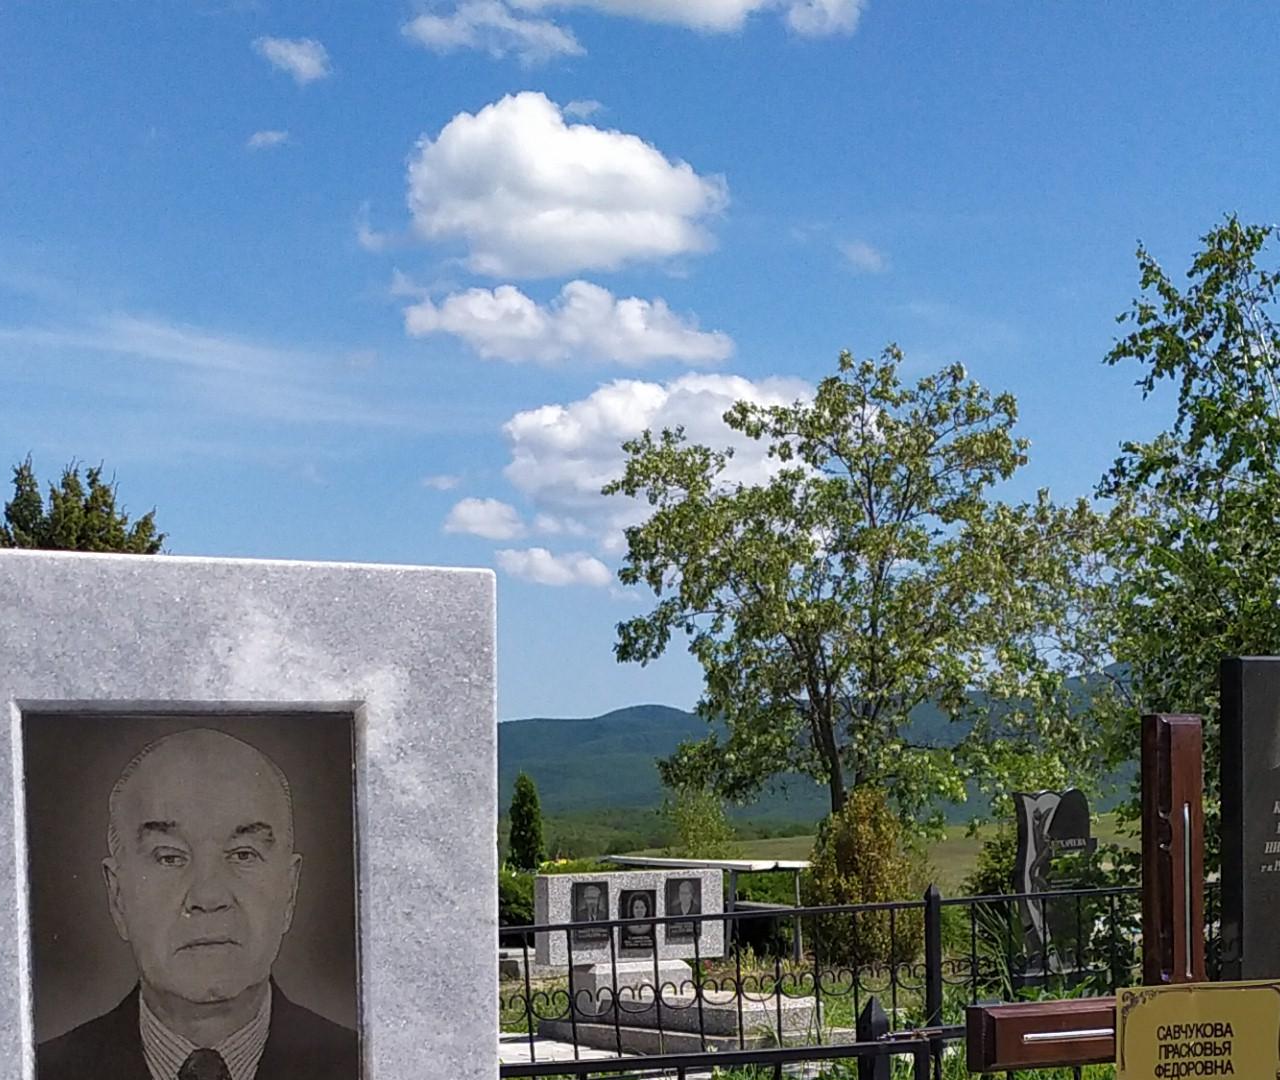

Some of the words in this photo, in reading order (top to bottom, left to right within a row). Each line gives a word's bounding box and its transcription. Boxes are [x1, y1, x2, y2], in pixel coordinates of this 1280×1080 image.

[1157, 1023, 1234, 1041] САВЧУКОВА
[1158, 1041, 1232, 1060] ПРАСКОВЬЯ
[1154, 1060, 1234, 1080] ФЕДОРОВНА
